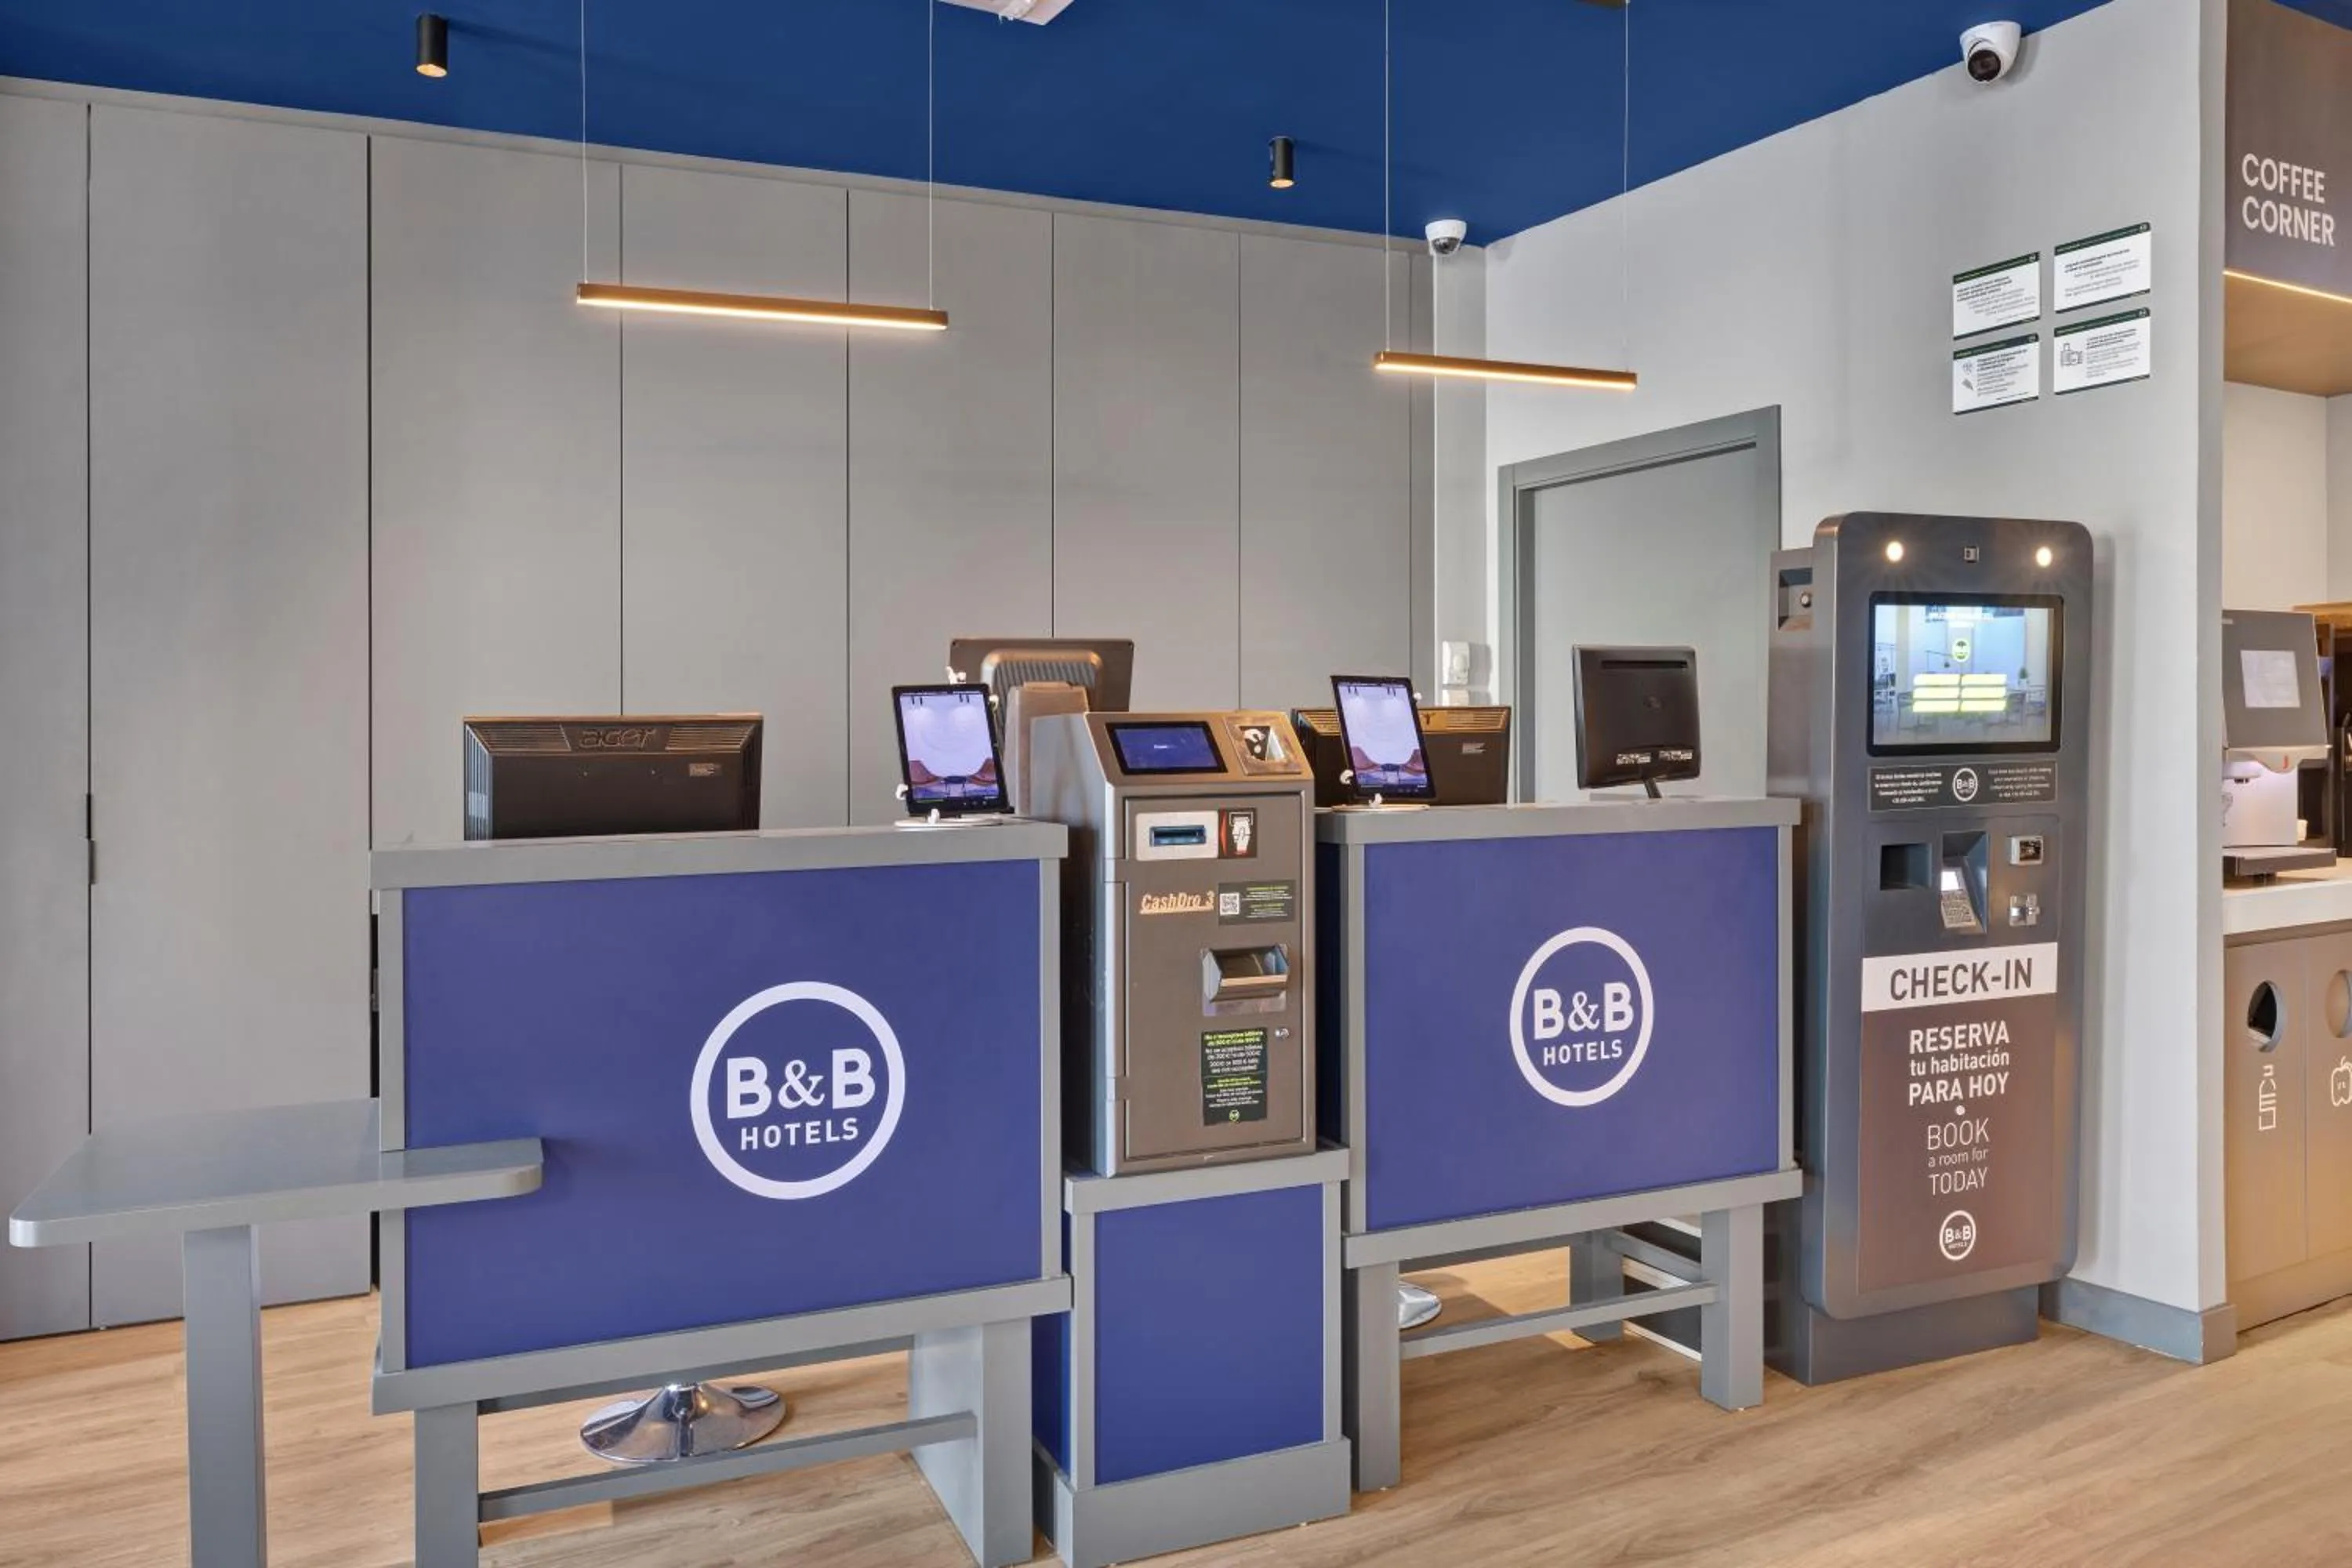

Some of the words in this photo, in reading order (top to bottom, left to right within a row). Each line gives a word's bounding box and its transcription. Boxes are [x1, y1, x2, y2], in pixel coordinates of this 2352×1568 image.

[2242, 153, 2325, 204] COFFEE
[2242, 196, 2335, 247] CORNER
[579, 728, 656, 749] acer
[1142, 892, 1201, 910] CashDro
[1206, 891, 1214, 909] 3
[1889, 957, 2032, 1001] CHECK-IN
[1534, 982, 1634, 1040] B&B
[1543, 1039, 1623, 1067] HOTELS
[1909, 1020, 2010, 1054] RESERVA
[1910, 1059, 1926, 1076] tu
[1931, 1049, 2009, 1073] habitación
[727, 1048, 876, 1119] B&B
[1908, 1079, 1963, 1106] PARA
[1969, 1072, 2009, 1098] HOY
[740, 1117, 859, 1150] HOTELS
[1927, 1118, 1990, 1150] BOOK
[1928, 1156, 1936, 1167] a
[1939, 1152, 1969, 1166] room
[1972, 1147, 1988, 1161] for
[1928, 1167, 1988, 1196] TODAY
[1944, 1225, 1972, 1243] B&B
